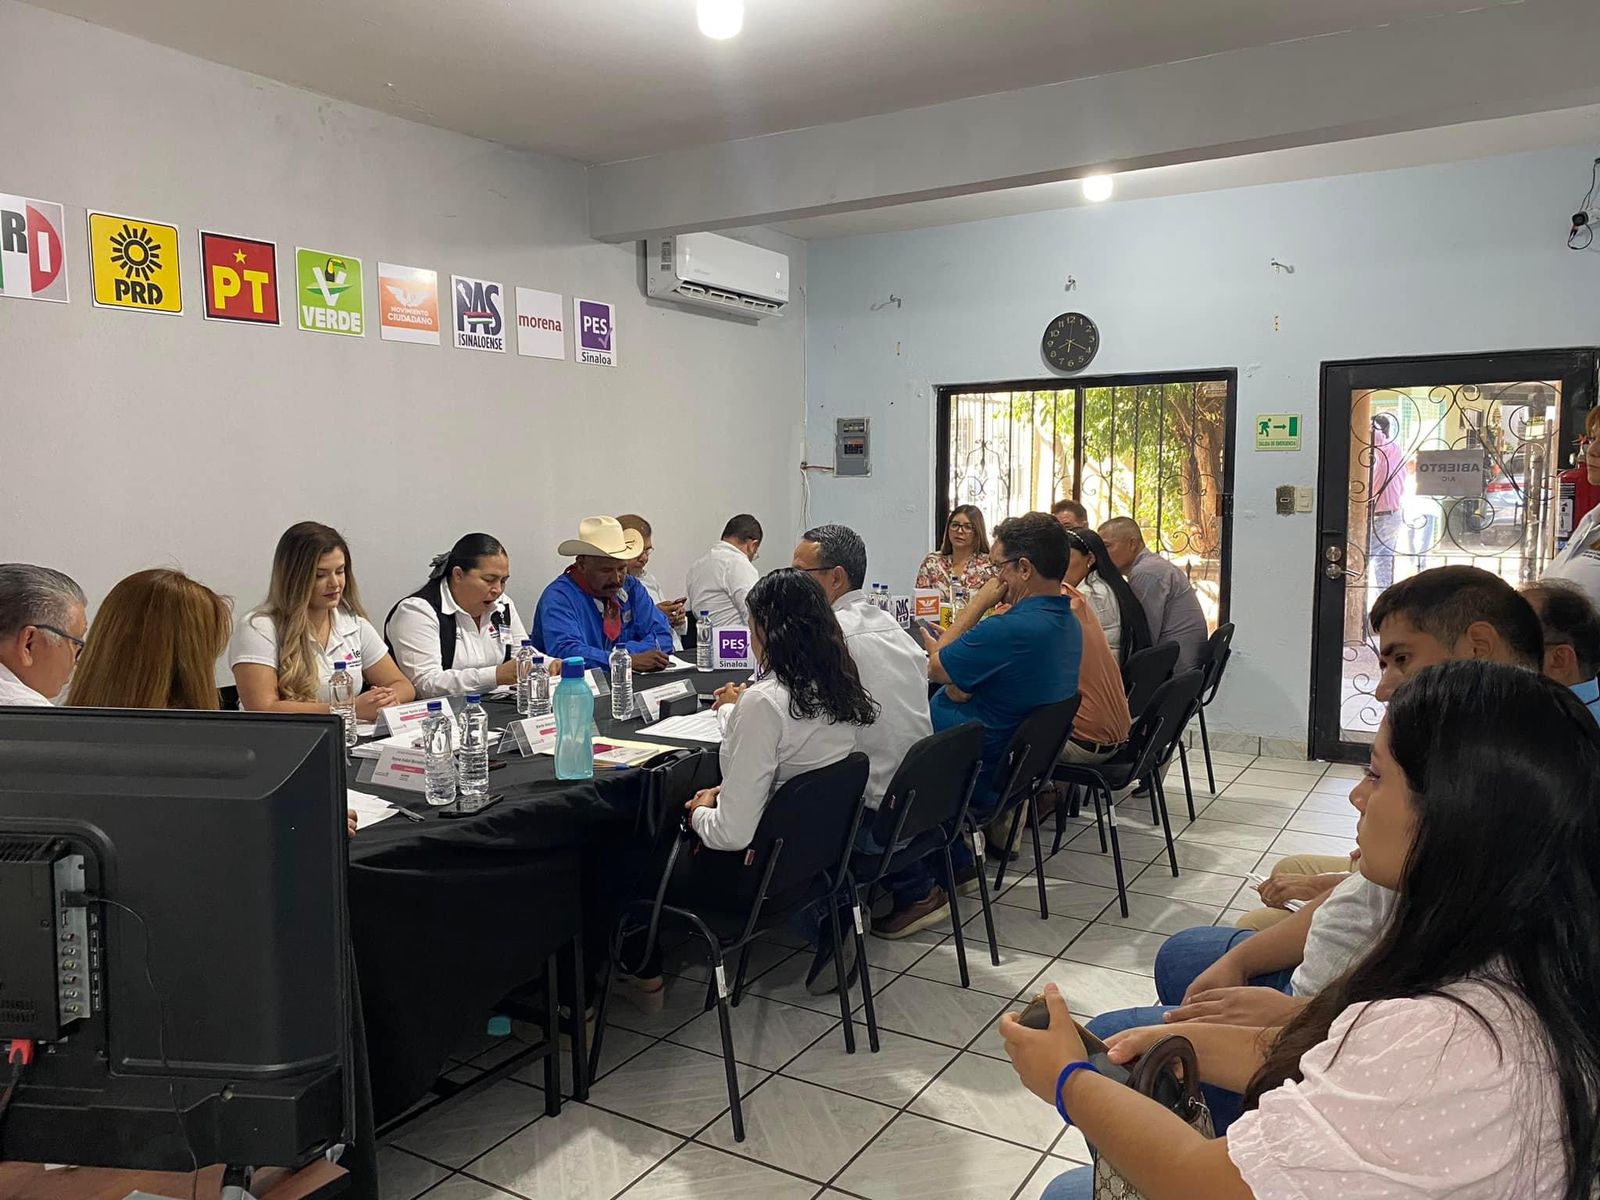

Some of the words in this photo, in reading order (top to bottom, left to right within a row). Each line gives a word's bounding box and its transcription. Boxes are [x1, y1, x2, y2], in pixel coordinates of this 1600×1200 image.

[0, 209, 51, 273] RI
[115, 278, 163, 305] PRD
[212, 265, 269, 314] PT
[391, 306, 429, 317] MOVIMIENTO
[455, 279, 502, 336] PAS
[302, 304, 361, 333] VERDE
[387, 312, 433, 325] CIUDADANO
[519, 314, 562, 332] morena
[583, 315, 608, 335] PES
[1067, 316, 1076, 324] 12
[461, 333, 502, 350] SINALOENSE
[581, 351, 612, 365] Sinaloa
[722, 638, 745, 650] PES
[719, 660, 748, 668] Sinaloa
